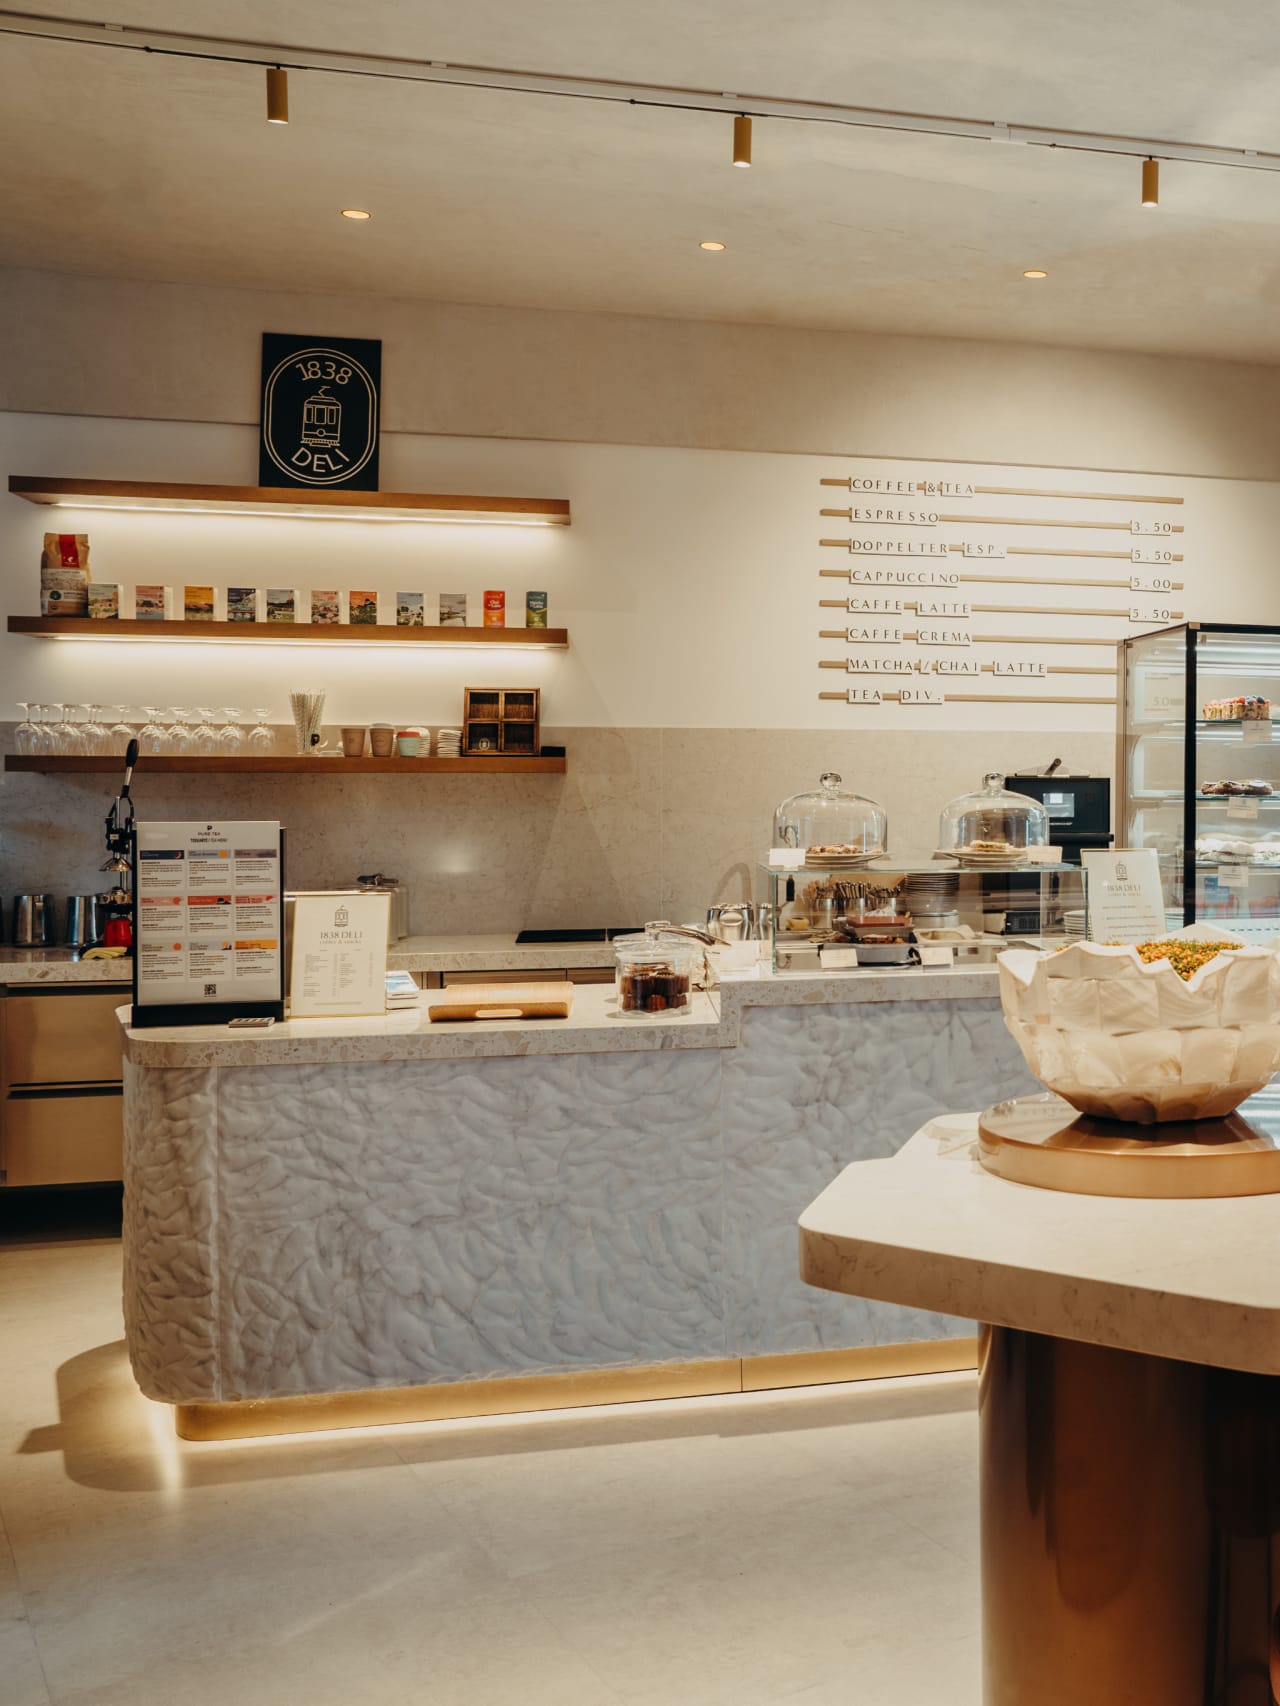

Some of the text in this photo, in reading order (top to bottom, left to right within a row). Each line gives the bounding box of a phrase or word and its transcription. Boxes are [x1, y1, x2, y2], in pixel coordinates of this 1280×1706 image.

[296, 361, 352, 385] 1838
[291, 447, 350, 473] DELI
[852, 479, 973, 494] COFFEE & TEA
[854, 509, 1171, 532] ESPRESSO 3.50
[852, 540, 1172, 561] DOPPELTER ESP. 5.50
[852, 570, 1171, 589] CAPPUCCINO 5.00
[850, 599, 1170, 619] CAFFE LATTE 5.50
[849, 628, 971, 642] CAFFE CREMA
[849, 659, 913, 671] MATCHA
[939, 661, 978, 672] CHAI
[996, 662, 1045, 673] LATTE
[851, 690, 882, 701] TEA
[901, 690, 941, 701] DIV.
